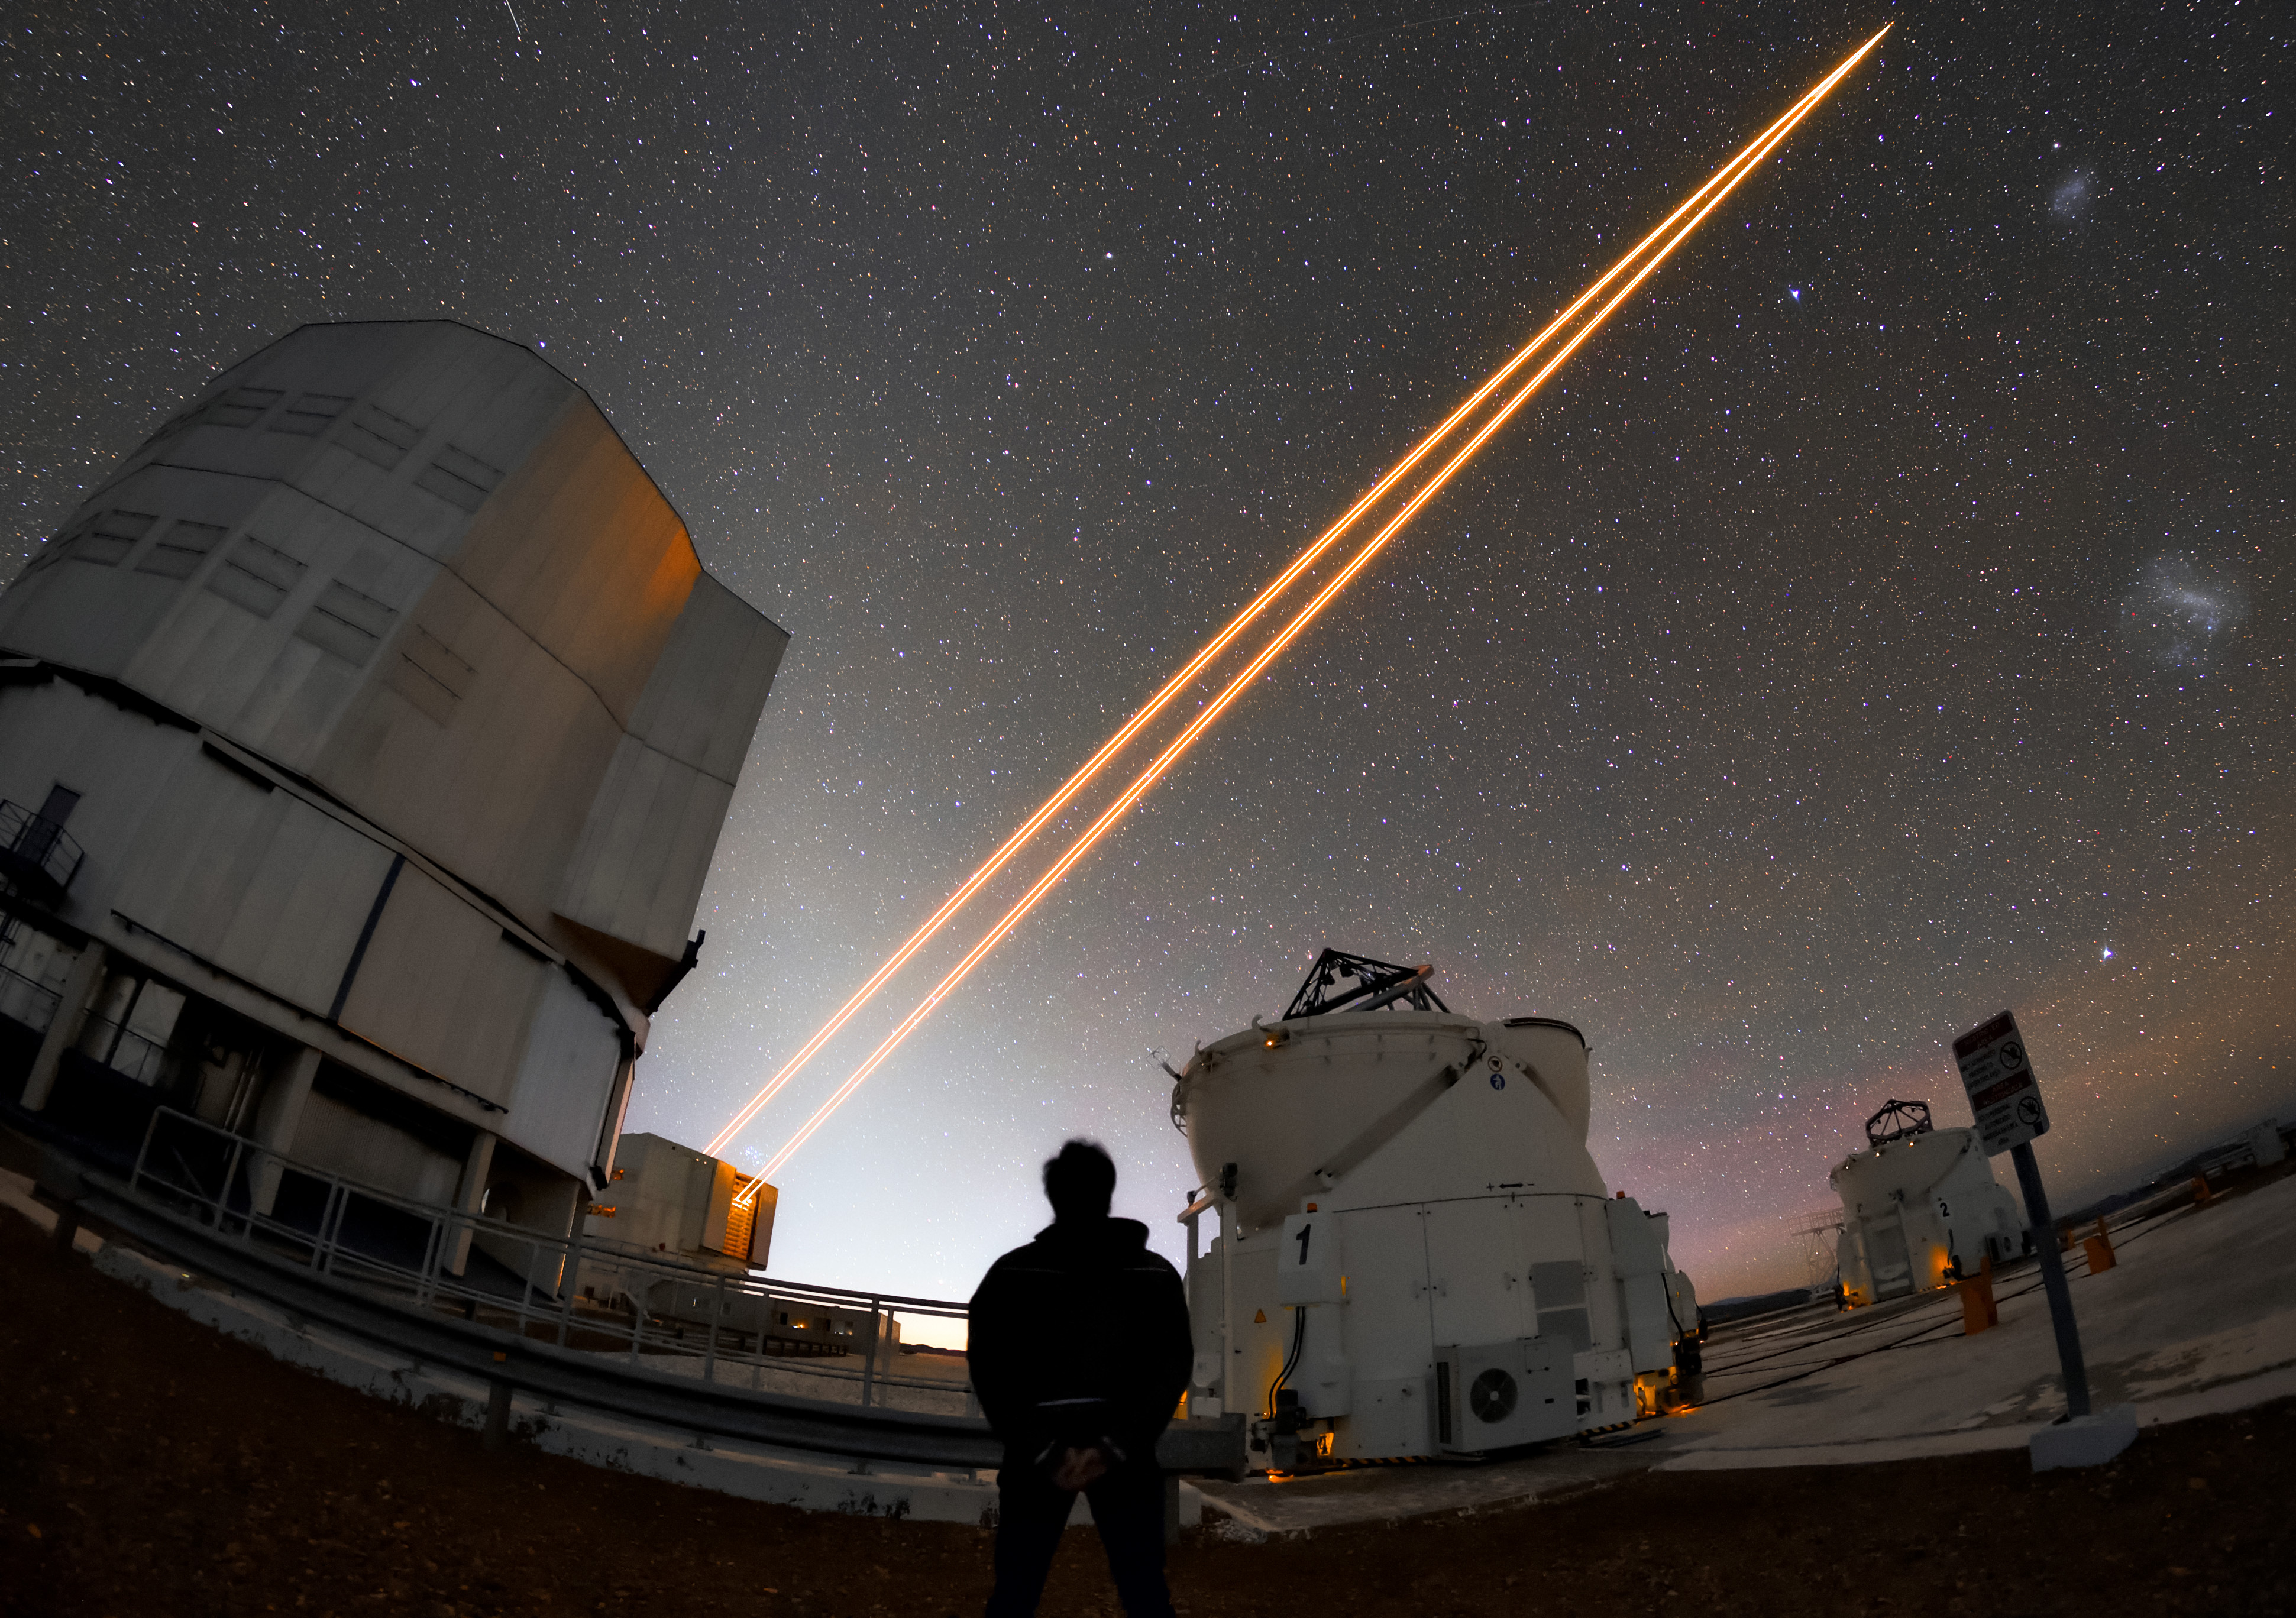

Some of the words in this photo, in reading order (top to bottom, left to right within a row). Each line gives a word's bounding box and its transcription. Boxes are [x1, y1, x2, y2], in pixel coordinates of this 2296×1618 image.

[1993, 1081, 2009, 1092] AREA
[1939, 1202, 1950, 1217] 2
[1296, 1224, 1311, 1265] 1
